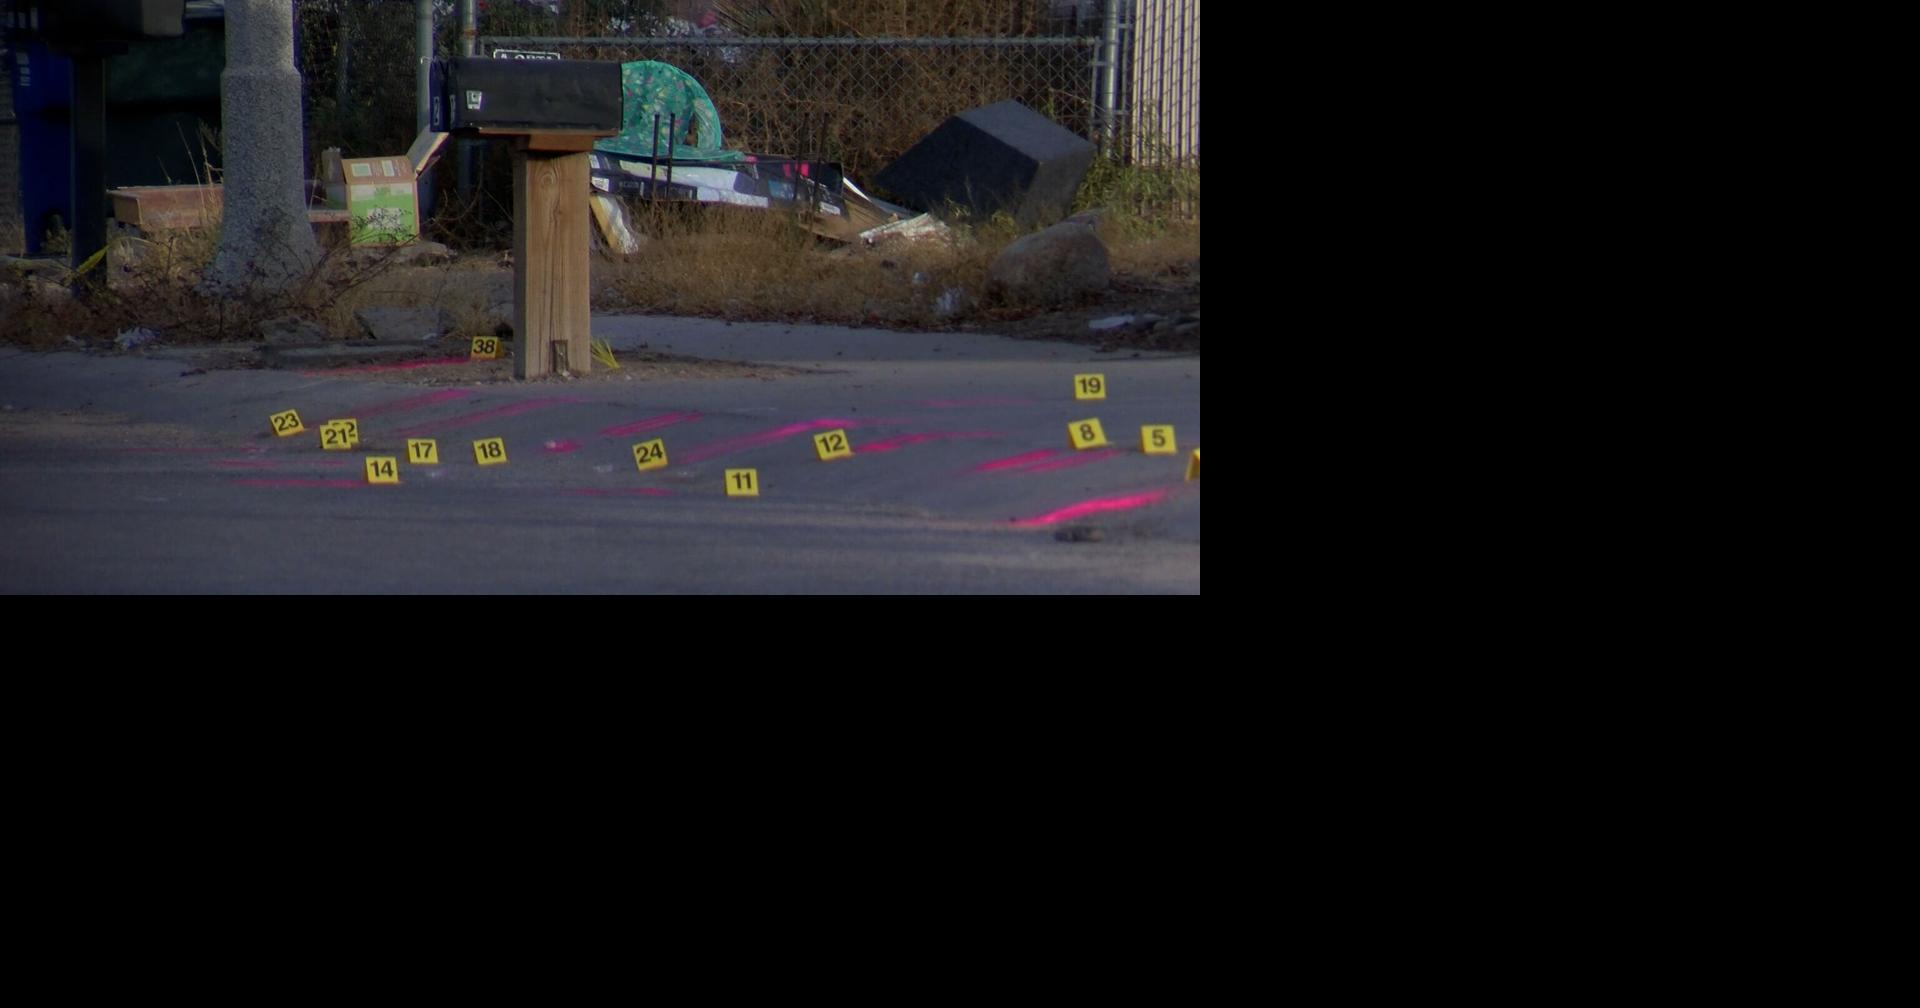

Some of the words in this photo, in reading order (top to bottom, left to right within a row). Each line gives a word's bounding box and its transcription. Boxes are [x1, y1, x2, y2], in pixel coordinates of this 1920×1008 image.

[474, 339, 495, 354] 38
[1080, 378, 1101, 394] 19
[274, 413, 299, 433] 23
[325, 428, 347, 444] 21
[1079, 424, 1095, 440] 8
[1151, 430, 1165, 448] 5
[411, 443, 432, 458] 17
[478, 442, 501, 458] 18
[819, 434, 844, 453] 12
[637, 443, 663, 463] 24
[370, 461, 394, 478] 14
[732, 473, 752, 490] 11
